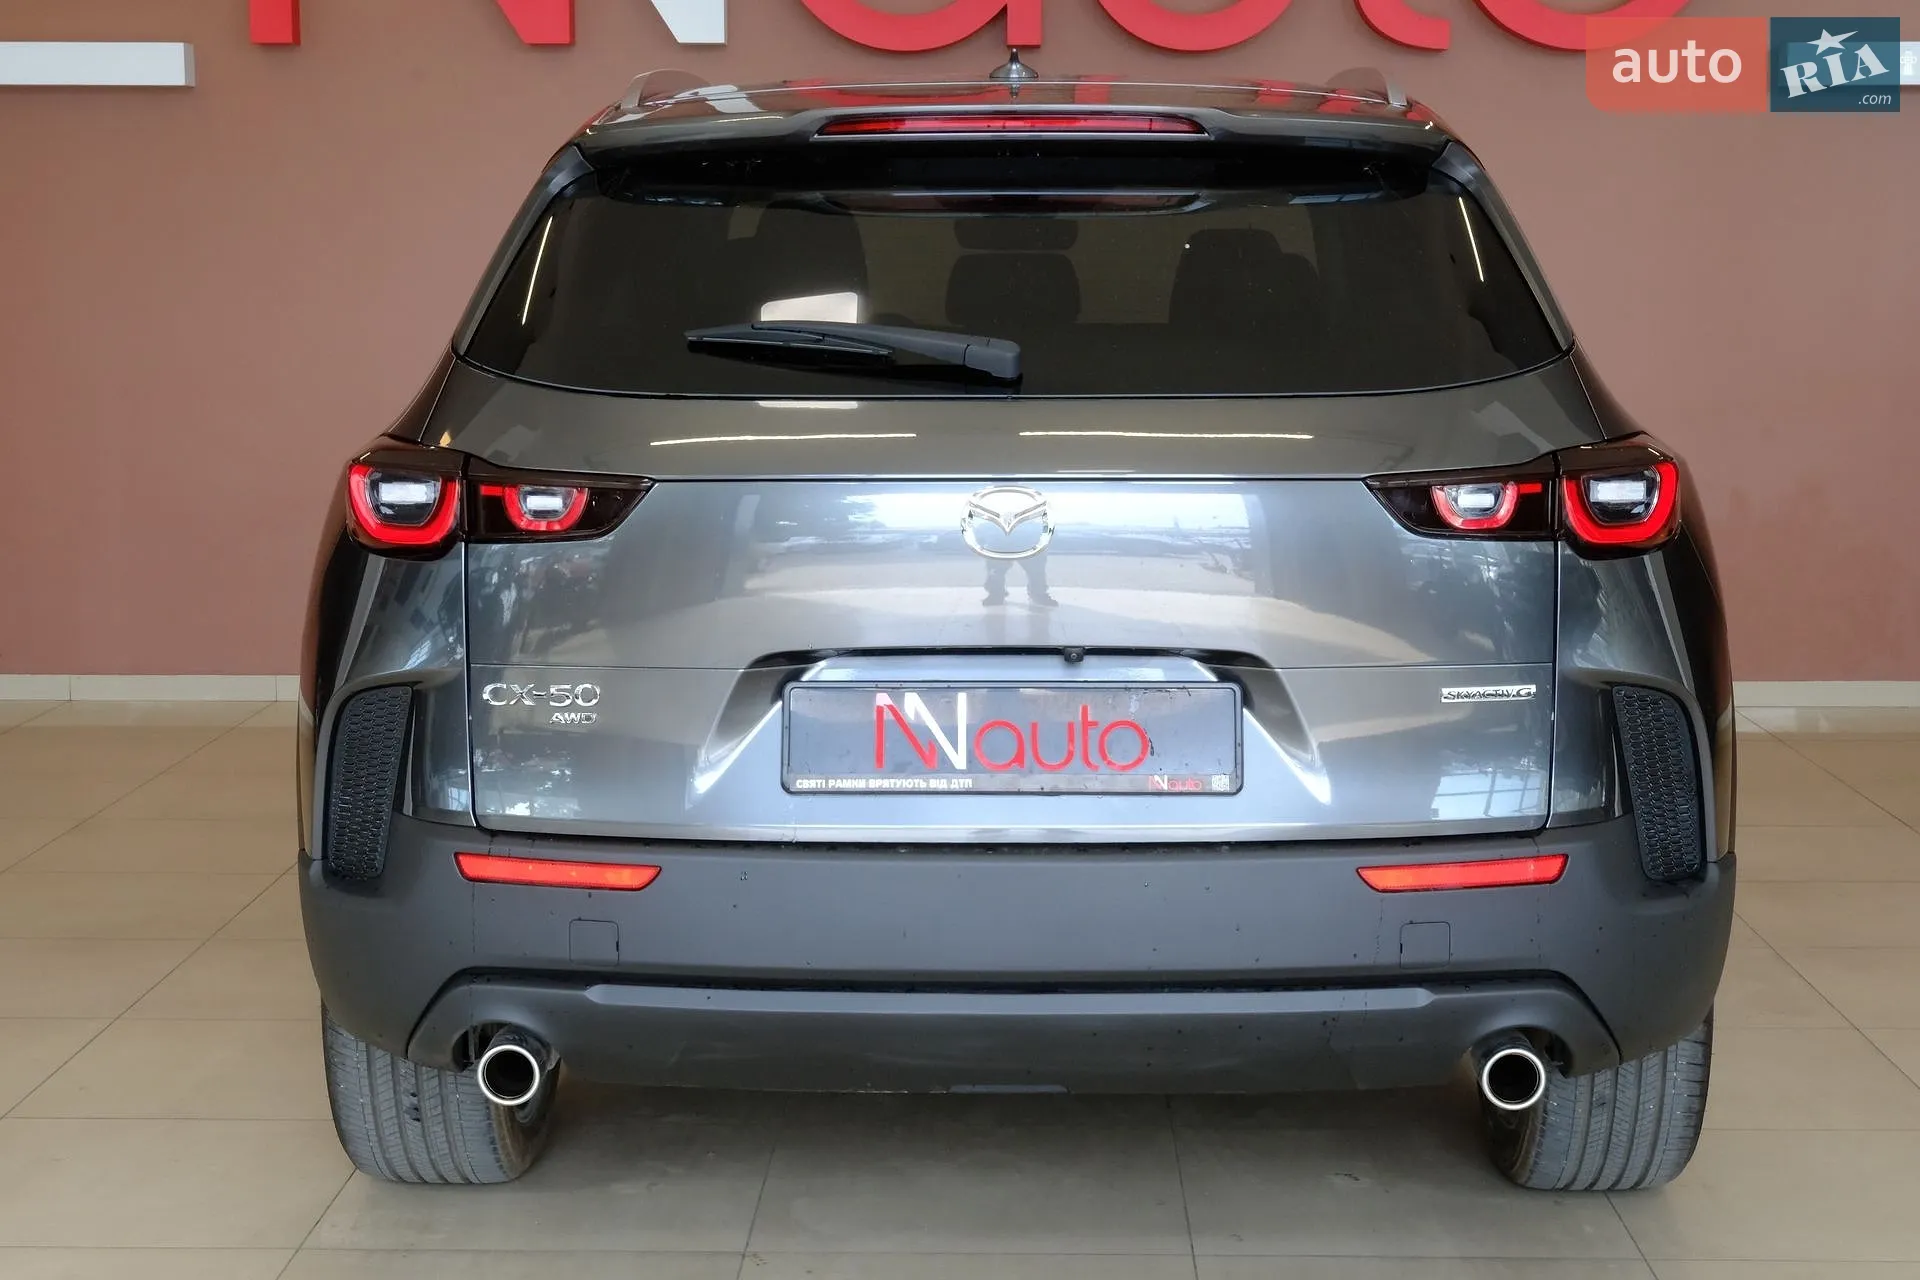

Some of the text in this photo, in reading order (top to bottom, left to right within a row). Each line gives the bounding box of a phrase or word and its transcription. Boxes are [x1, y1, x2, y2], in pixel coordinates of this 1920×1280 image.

[482, 683, 600, 707] CX-50
[549, 712, 597, 724] AWD
[796, 779, 826, 789] СВЯТІ
[828, 779, 867, 789] РАМКИ
[868, 779, 927, 789] ВРЯТУЮТЬ
[929, 779, 948, 790] ВІД
